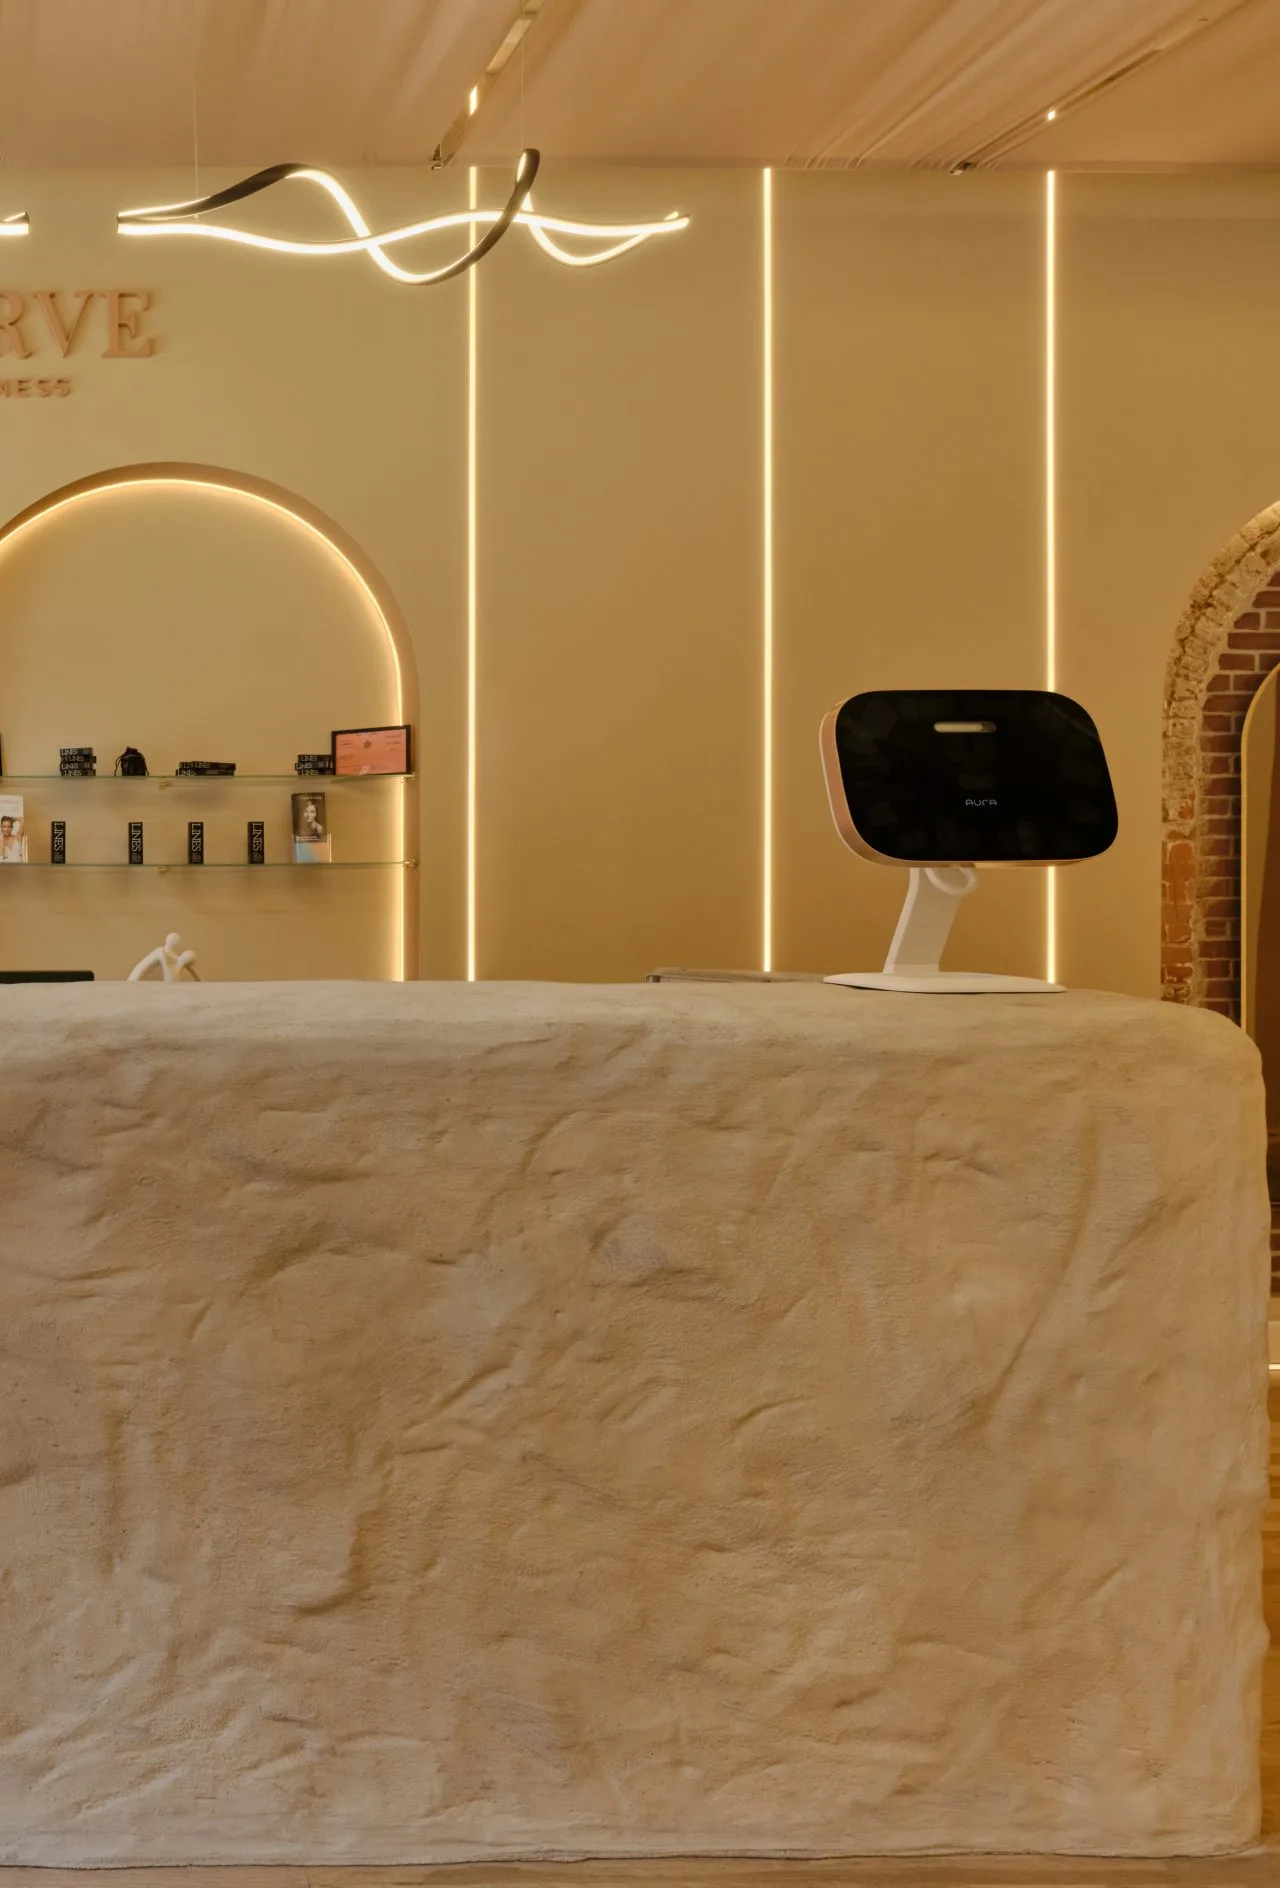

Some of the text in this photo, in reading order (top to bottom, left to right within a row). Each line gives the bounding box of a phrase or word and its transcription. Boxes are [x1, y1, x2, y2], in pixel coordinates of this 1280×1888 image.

[54, 822, 64, 851] LINES
[131, 823, 141, 852] LINES
[191, 823, 201, 852] LINES
[252, 823, 263, 851] LINES
